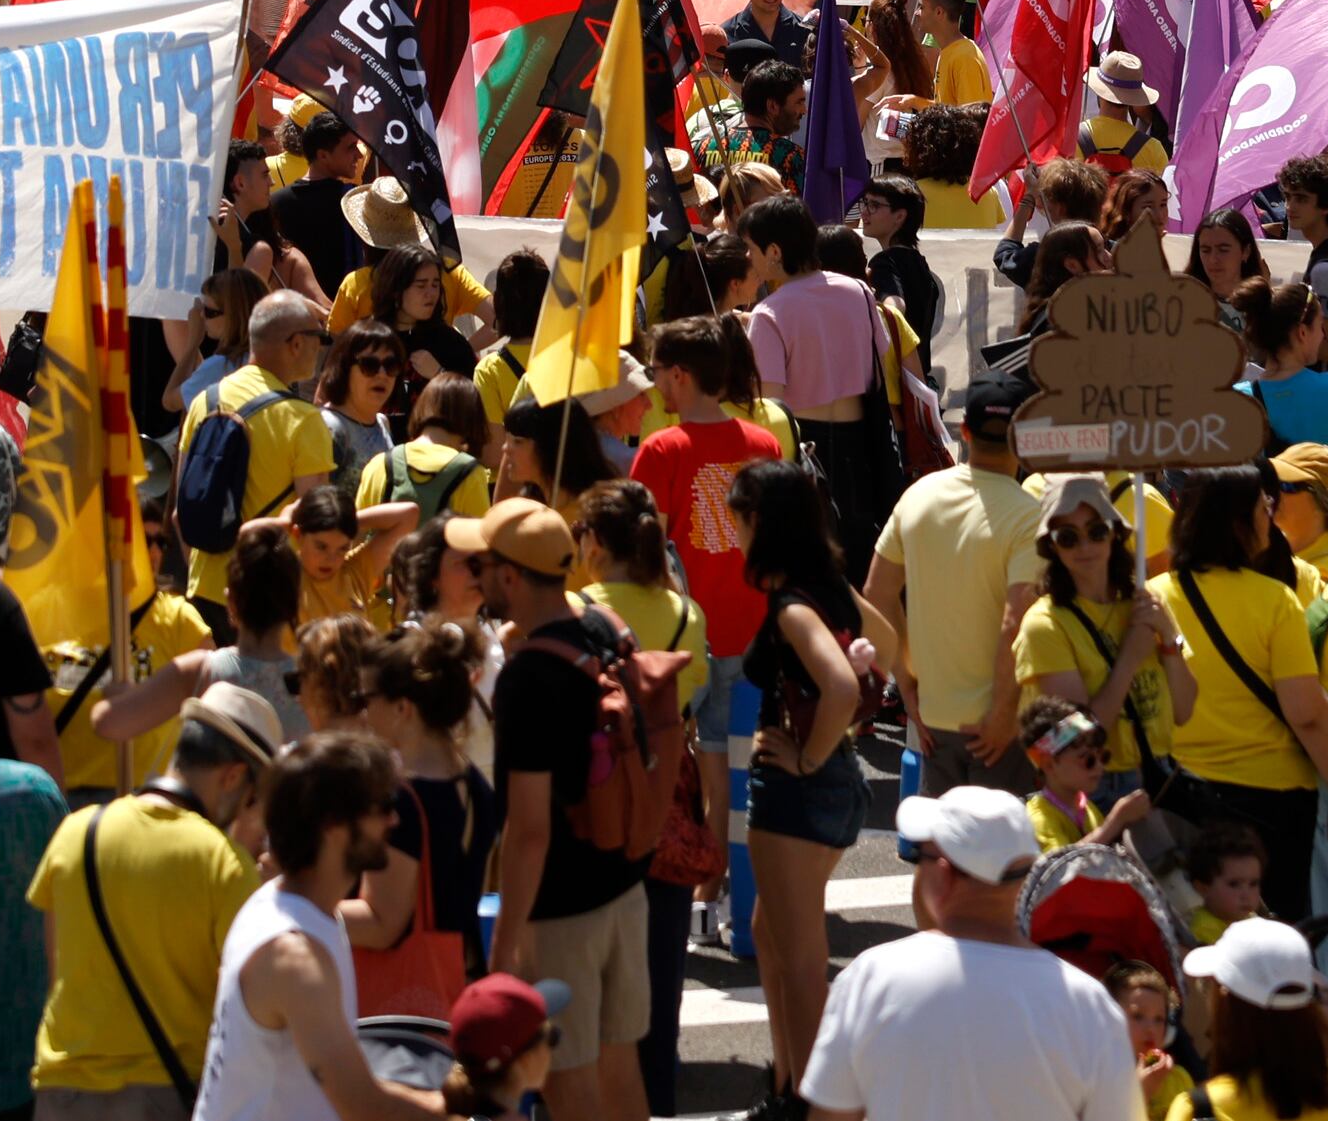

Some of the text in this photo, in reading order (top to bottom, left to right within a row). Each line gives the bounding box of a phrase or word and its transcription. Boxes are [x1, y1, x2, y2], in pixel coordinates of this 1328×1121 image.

[330, 29, 361, 57] Sindicat
[359, 51, 403, 98] d'Estudiants
[1081, 384, 1173, 418] PACTE
[1110, 413, 1231, 458] PUDOR
